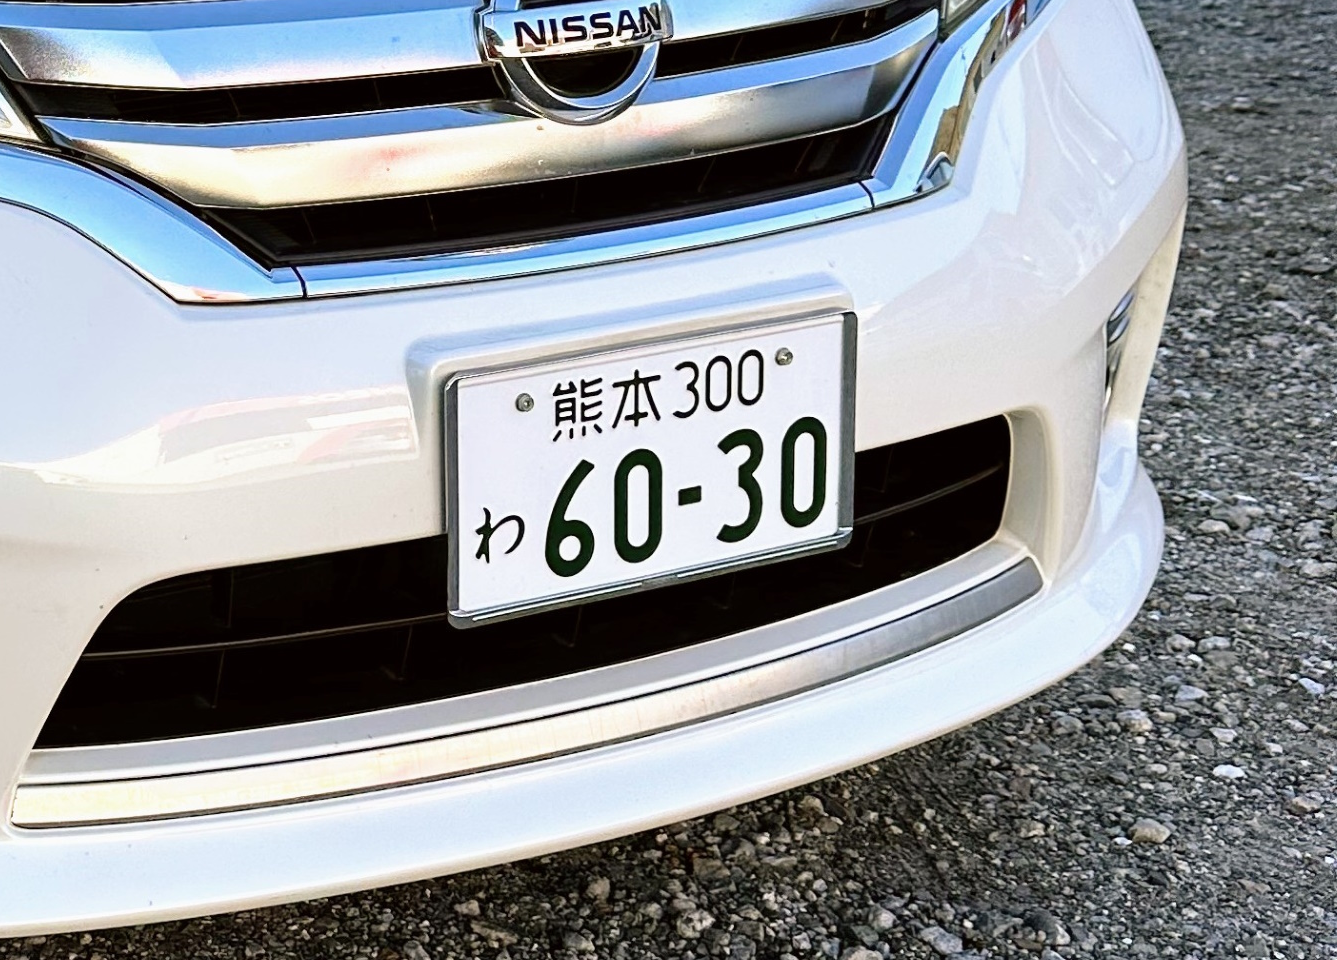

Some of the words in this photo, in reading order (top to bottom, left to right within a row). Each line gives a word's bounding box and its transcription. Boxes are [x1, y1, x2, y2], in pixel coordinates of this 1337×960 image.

[514, 2, 662, 47] NISSAN
[552, 369, 661, 442] 熊本
[673, 349, 764, 418] 300
[475, 507, 526, 564] わ
[545, 416, 828, 578] 60-30
